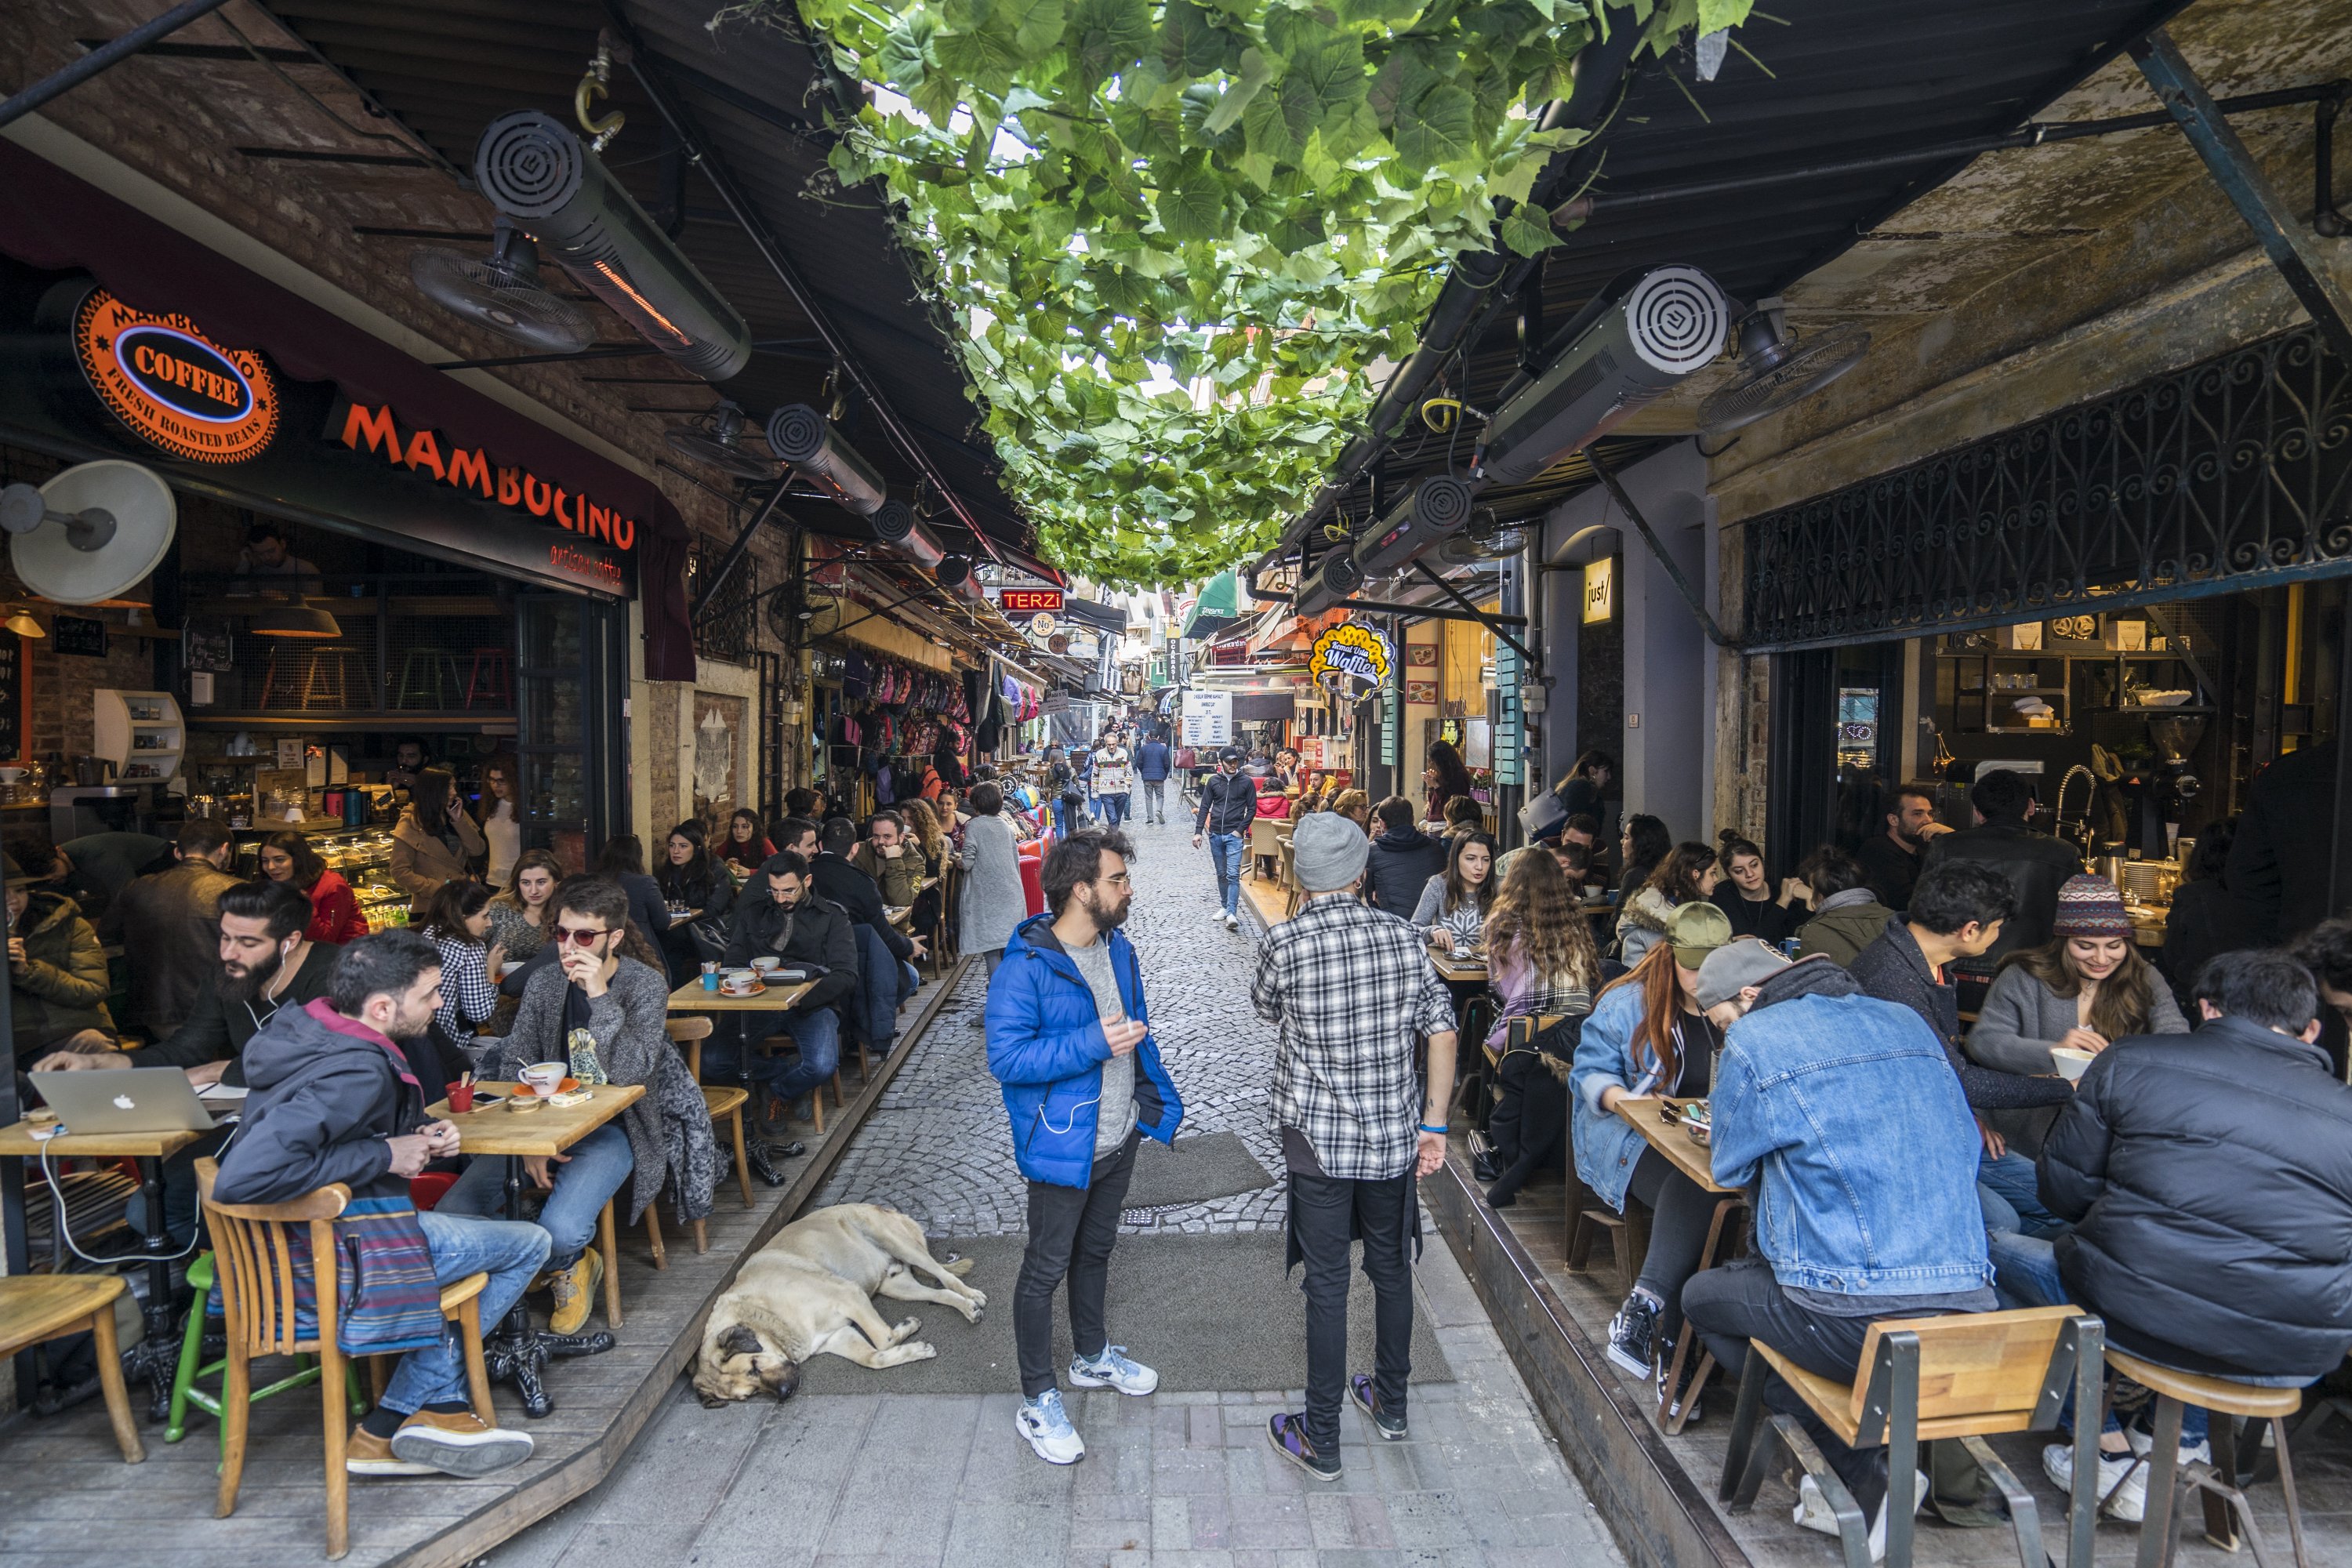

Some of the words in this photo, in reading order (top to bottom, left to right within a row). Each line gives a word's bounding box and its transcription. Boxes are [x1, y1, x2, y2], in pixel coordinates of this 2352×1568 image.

[135, 344, 239, 408] COFFEE
[107, 367, 156, 422] FRESH
[160, 415, 223, 448] ROASTED
[227, 417, 262, 447] BEANS
[341, 402, 635, 551] MAMBOCINO
[550, 544, 590, 576] artisan
[593, 557, 622, 586] coffee
[1324, 649, 1377, 674] Waffles
[1331, 641, 1352, 653] Kemal
[1353, 646, 1369, 657] Usta
